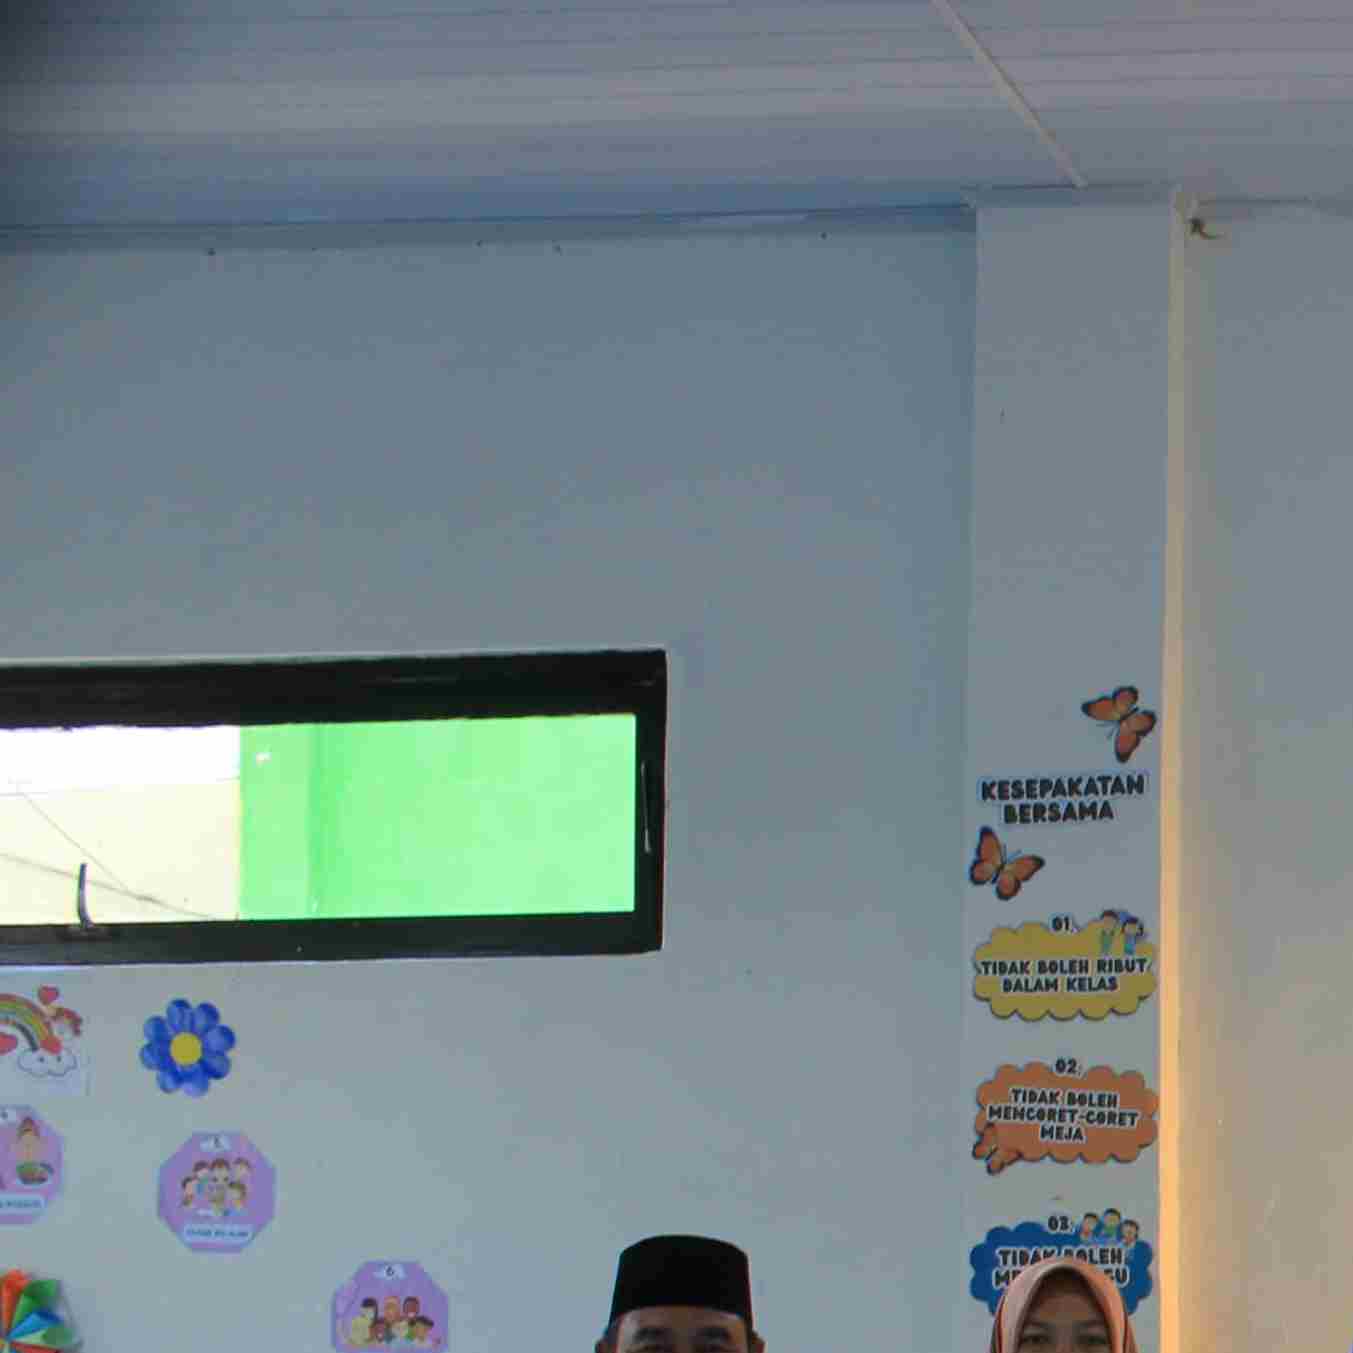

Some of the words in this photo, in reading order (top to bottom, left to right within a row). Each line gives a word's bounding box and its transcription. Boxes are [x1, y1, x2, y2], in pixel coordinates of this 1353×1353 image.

[981, 774, 1144, 801] KESEPAKATAN
[1003, 800, 1114, 824] BERSAMA
[981, 961, 1031, 976] TIDAK
[1037, 960, 1089, 975] BOLEH
[1097, 958, 1147, 974] RIBUT
[1002, 977, 1059, 993] DALAM
[1066, 976, 1118, 992] KELAS
[1011, 1089, 1061, 1105] TIDAK
[1066, 1091, 1118, 1108] BOLEH
[1040, 1126, 1084, 1141] MEJA
